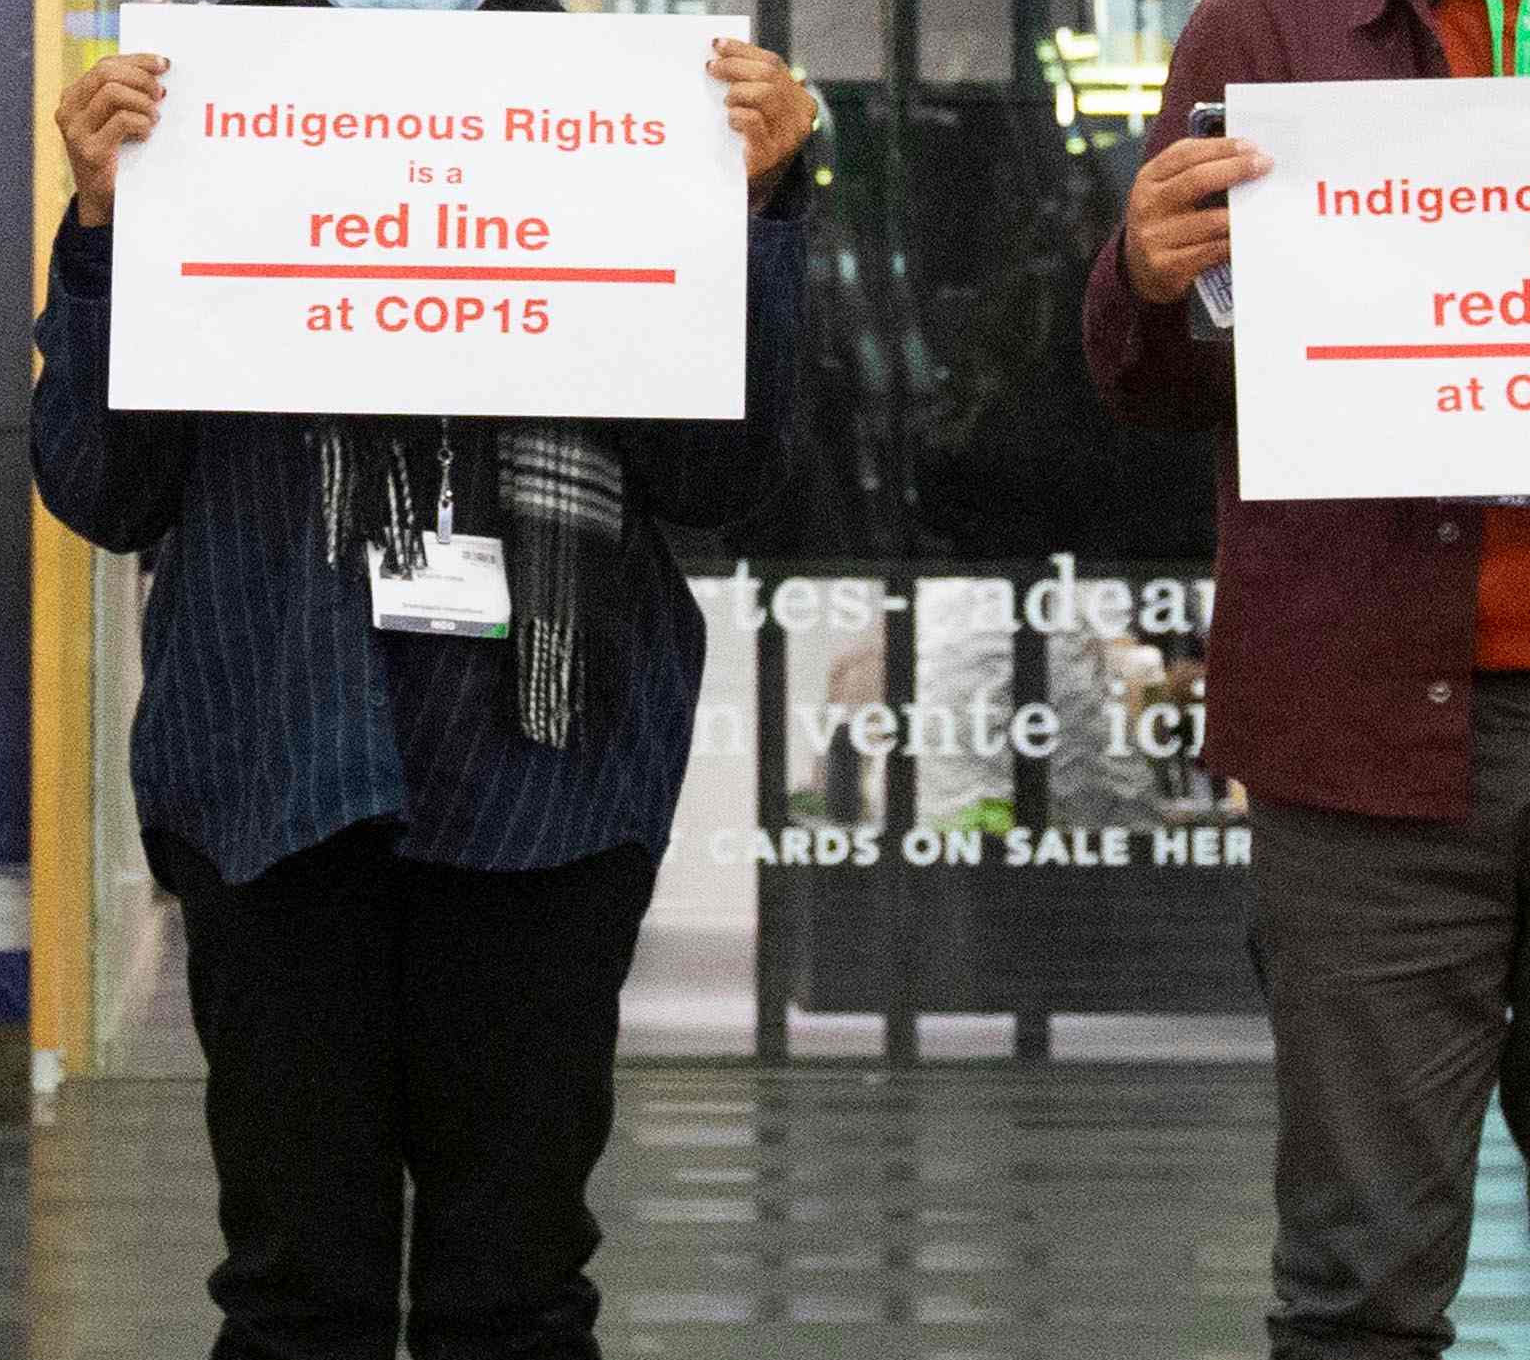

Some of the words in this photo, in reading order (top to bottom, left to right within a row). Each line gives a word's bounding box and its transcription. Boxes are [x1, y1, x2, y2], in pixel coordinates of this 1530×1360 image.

[203, 102, 484, 148] Indigenous
[504, 106, 667, 153] Rights
[408, 159, 435, 185] is
[445, 165, 464, 186] a
[308, 201, 411, 250] red
[436, 202, 551, 252] line
[305, 296, 354, 334] at
[374, 294, 550, 336] COP15
[1436, 376, 1484, 414] at
[793, 689, 1061, 759] vente
[710, 825, 878, 866] CARDS
[904, 825, 982, 866] ON
[1005, 825, 1130, 867] SALE
